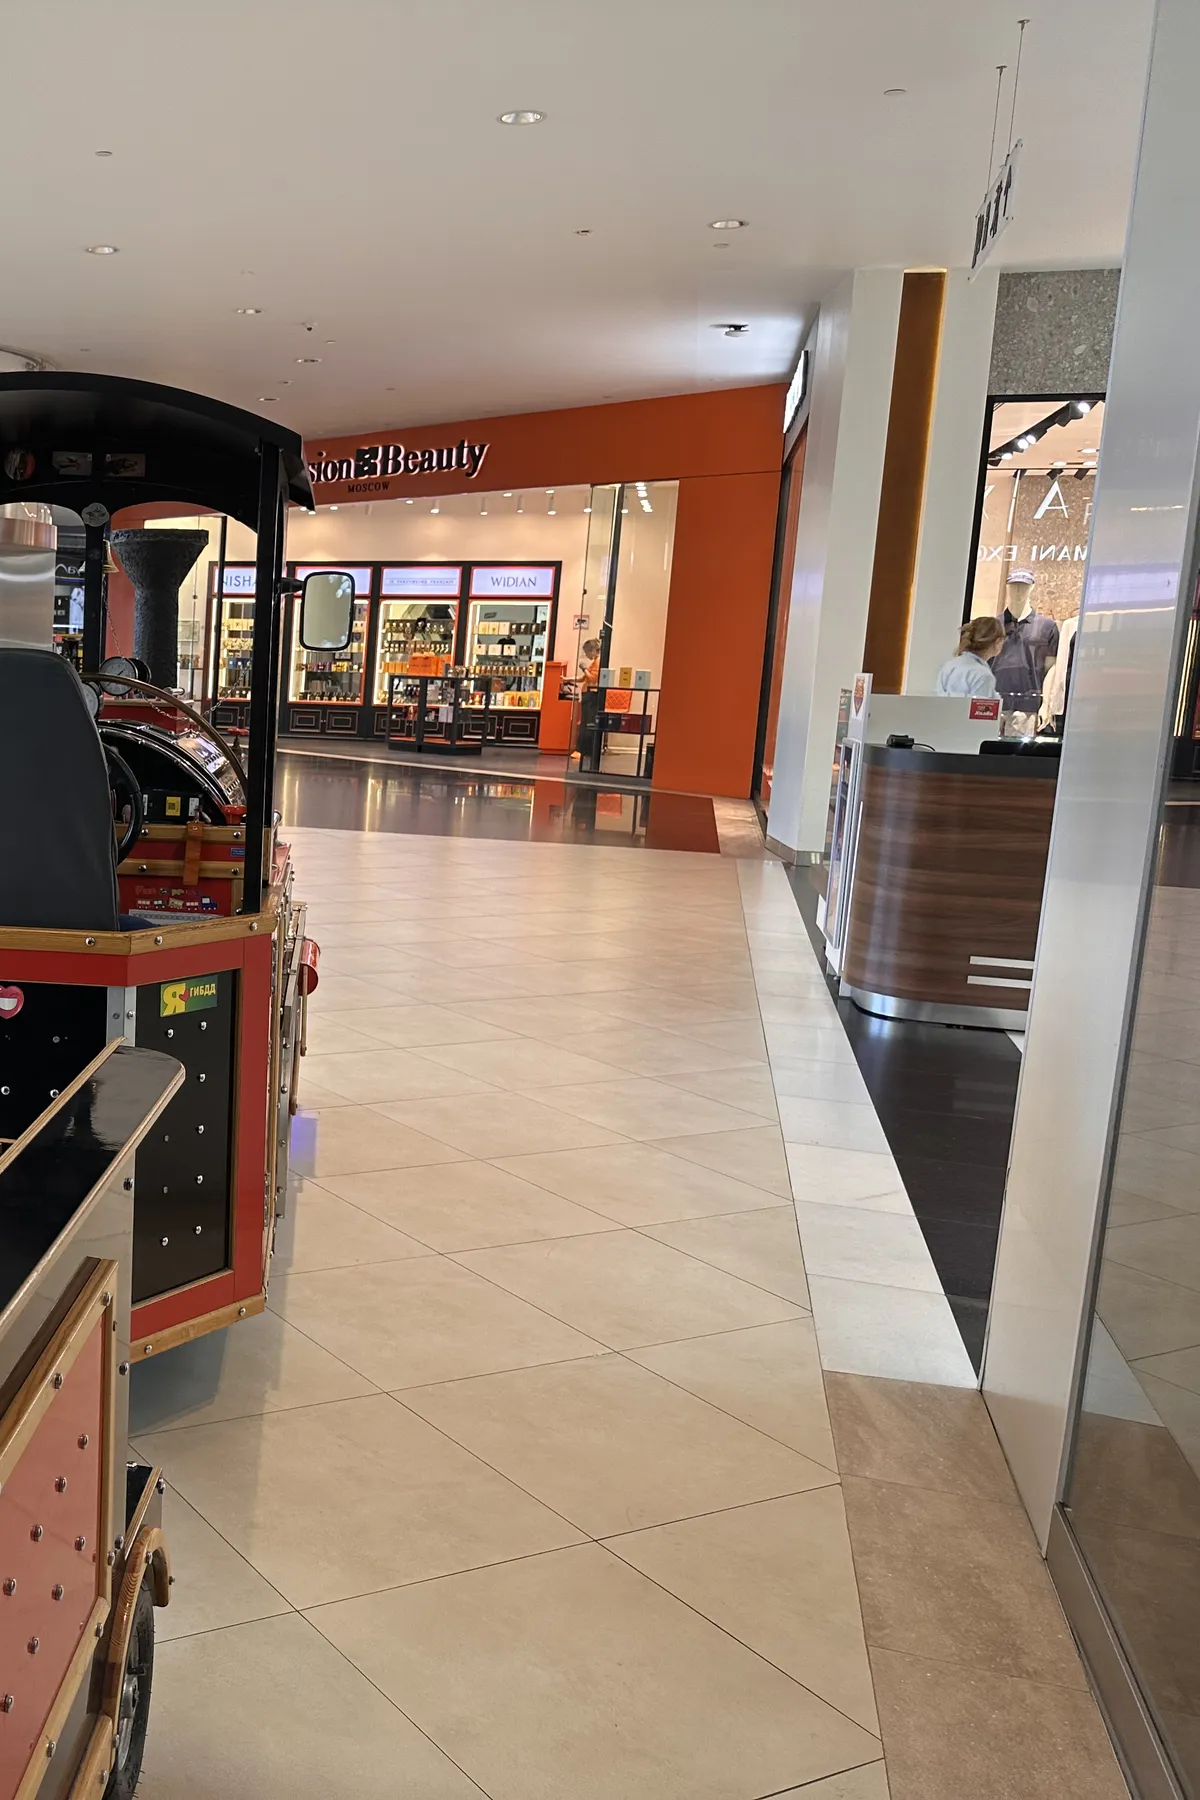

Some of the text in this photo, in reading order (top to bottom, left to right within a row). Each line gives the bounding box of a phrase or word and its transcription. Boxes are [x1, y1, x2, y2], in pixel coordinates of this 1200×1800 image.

[381, 438, 490, 479] Beauty
[347, 481, 390, 494] MOSCOW
[222, 575, 256, 587] NISH
[490, 576, 537, 588] WIDIAN
[162, 983, 216, 1016] Я ГИБДД
